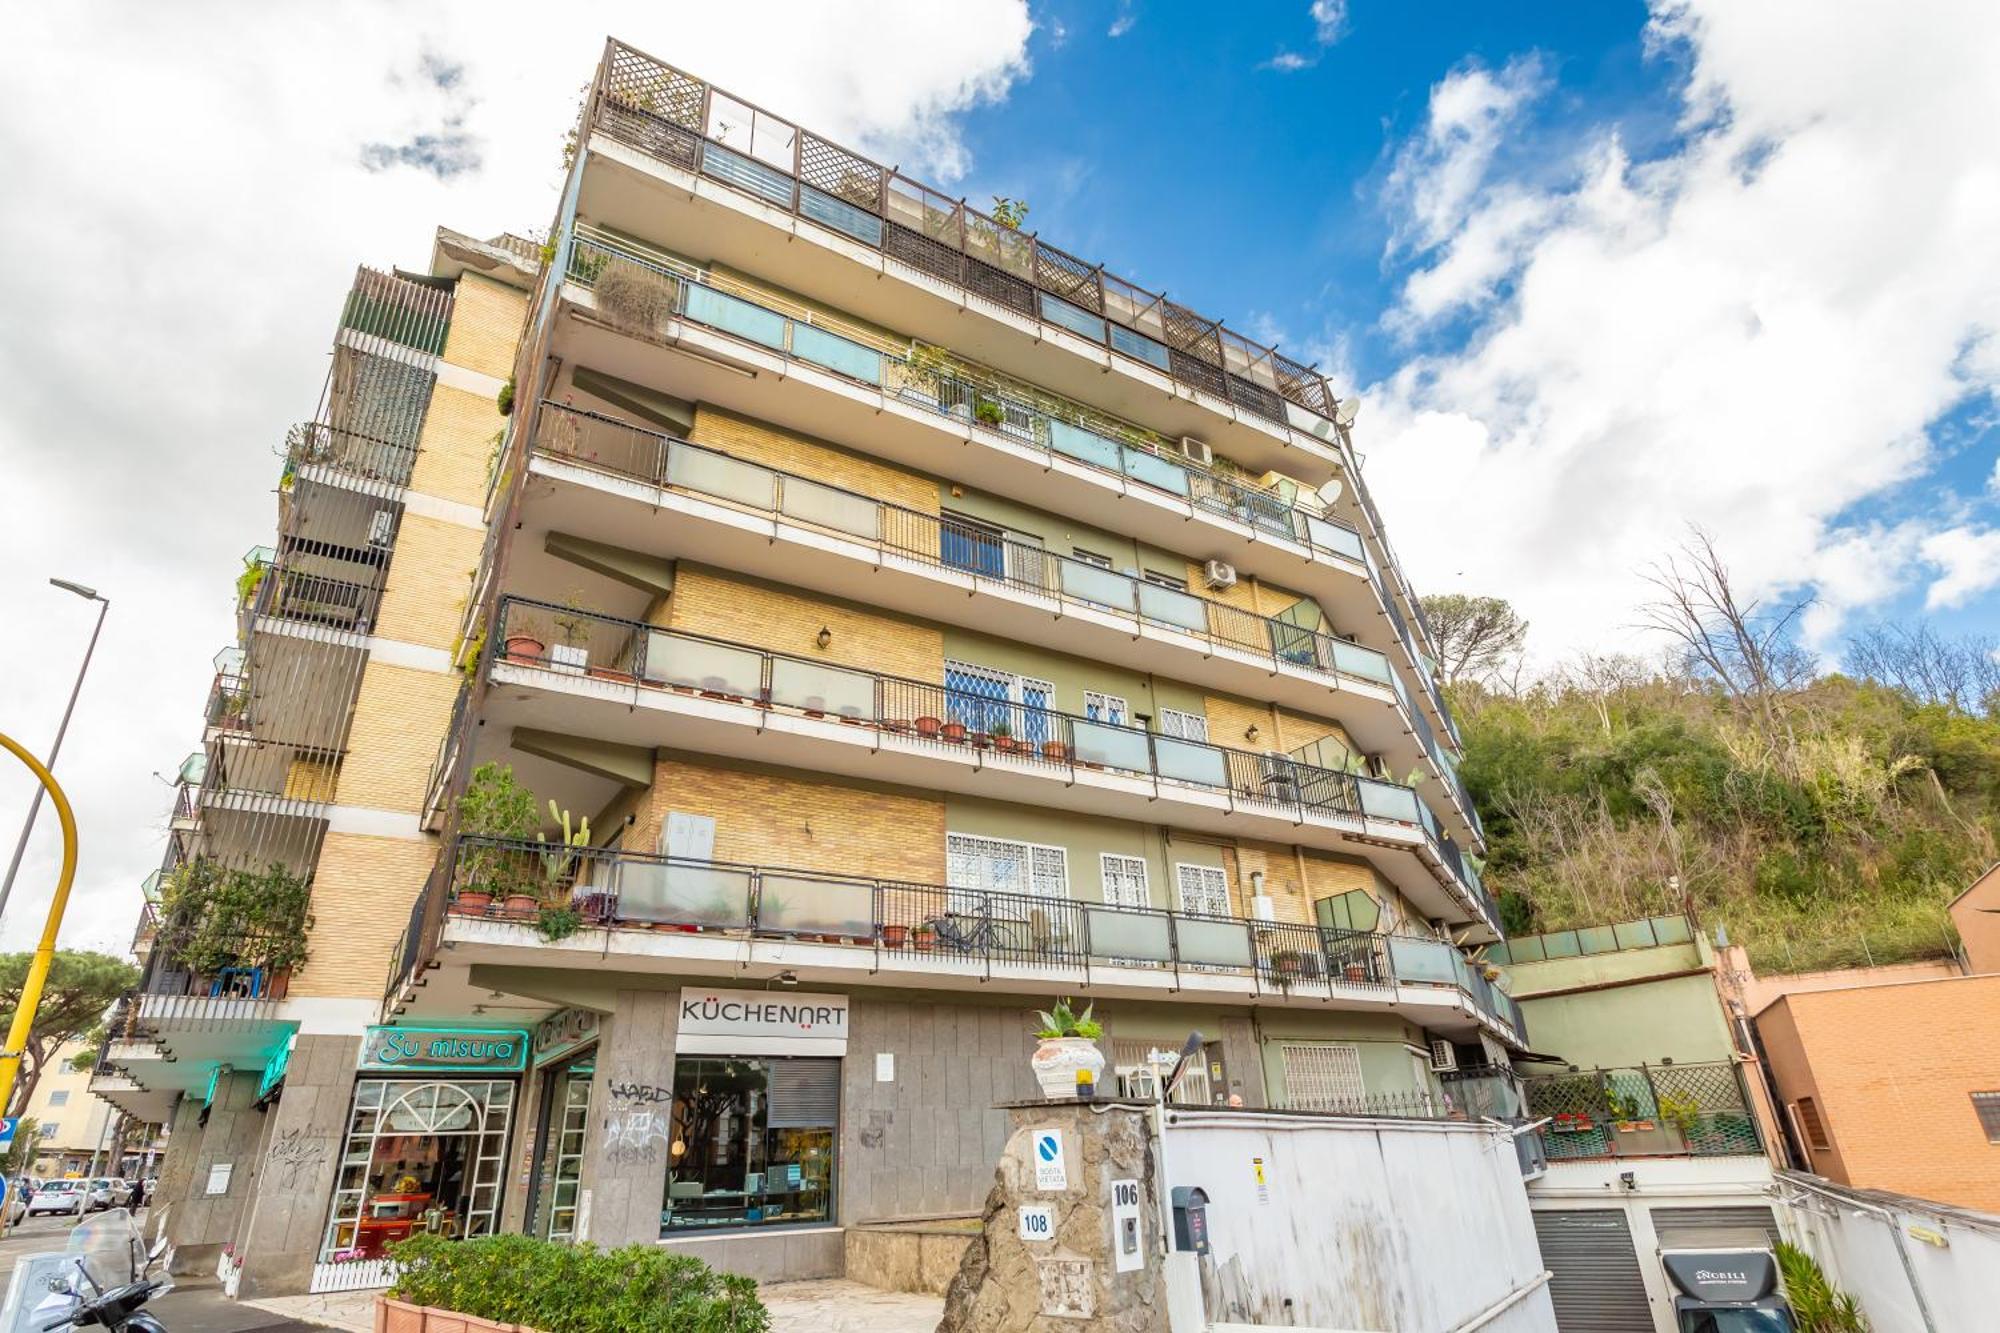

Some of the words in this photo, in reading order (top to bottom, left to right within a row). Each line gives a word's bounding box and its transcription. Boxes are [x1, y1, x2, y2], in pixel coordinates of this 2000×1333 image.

[379, 1033, 420, 1063] Su
[430, 1039, 513, 1060] misura
[1114, 1184, 1138, 1206] 106
[1025, 1214, 1048, 1233] 108
